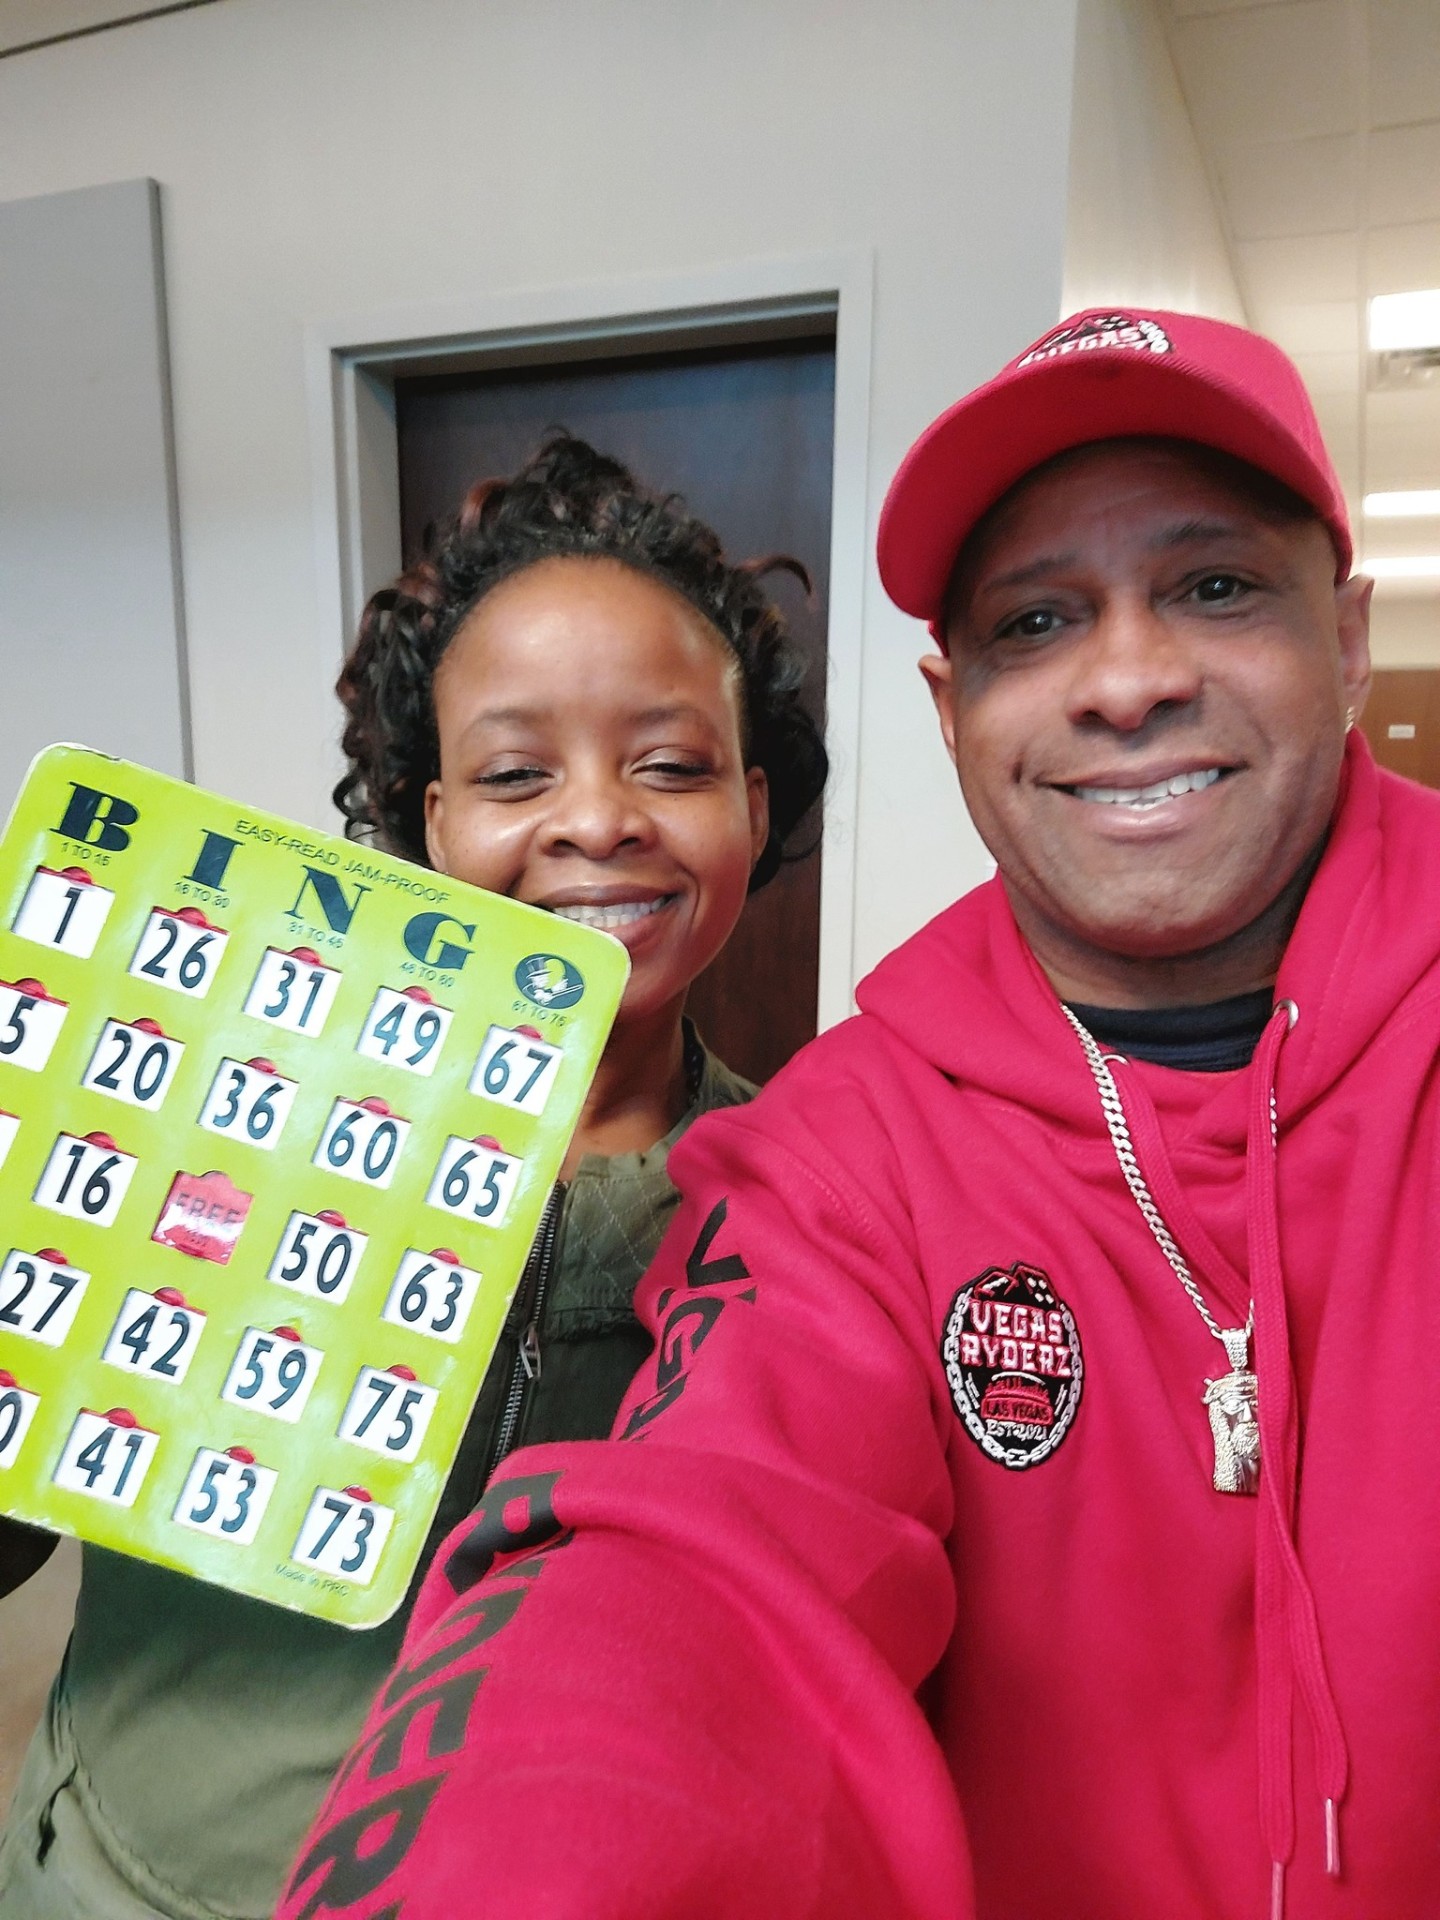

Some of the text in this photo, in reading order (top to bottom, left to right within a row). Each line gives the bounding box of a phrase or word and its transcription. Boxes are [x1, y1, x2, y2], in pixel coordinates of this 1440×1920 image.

[72, 845, 91, 859] TO
[192, 886, 211, 902] TO
[308, 928, 326, 942] TO
[54, 887, 553, 1103] 1 26 31 49 67
[418, 967, 437, 981] TO
[0, 995, 509, 1217] 5 20 36 60 65
[56, 1144, 122, 1214] 16
[280, 1222, 352, 1294] 50
[400, 1263, 464, 1332] 63
[969, 1300, 1065, 1344] VEGAS
[0, 1261, 425, 1450] 27 42 59 75
[961, 1332, 1072, 1378] RYDERZ
[986, 1401, 1050, 1421] LAS VEGAS
[76, 1426, 145, 1497] 41
[190, 1460, 257, 1533] 53
[308, 1497, 375, 1573] 73
